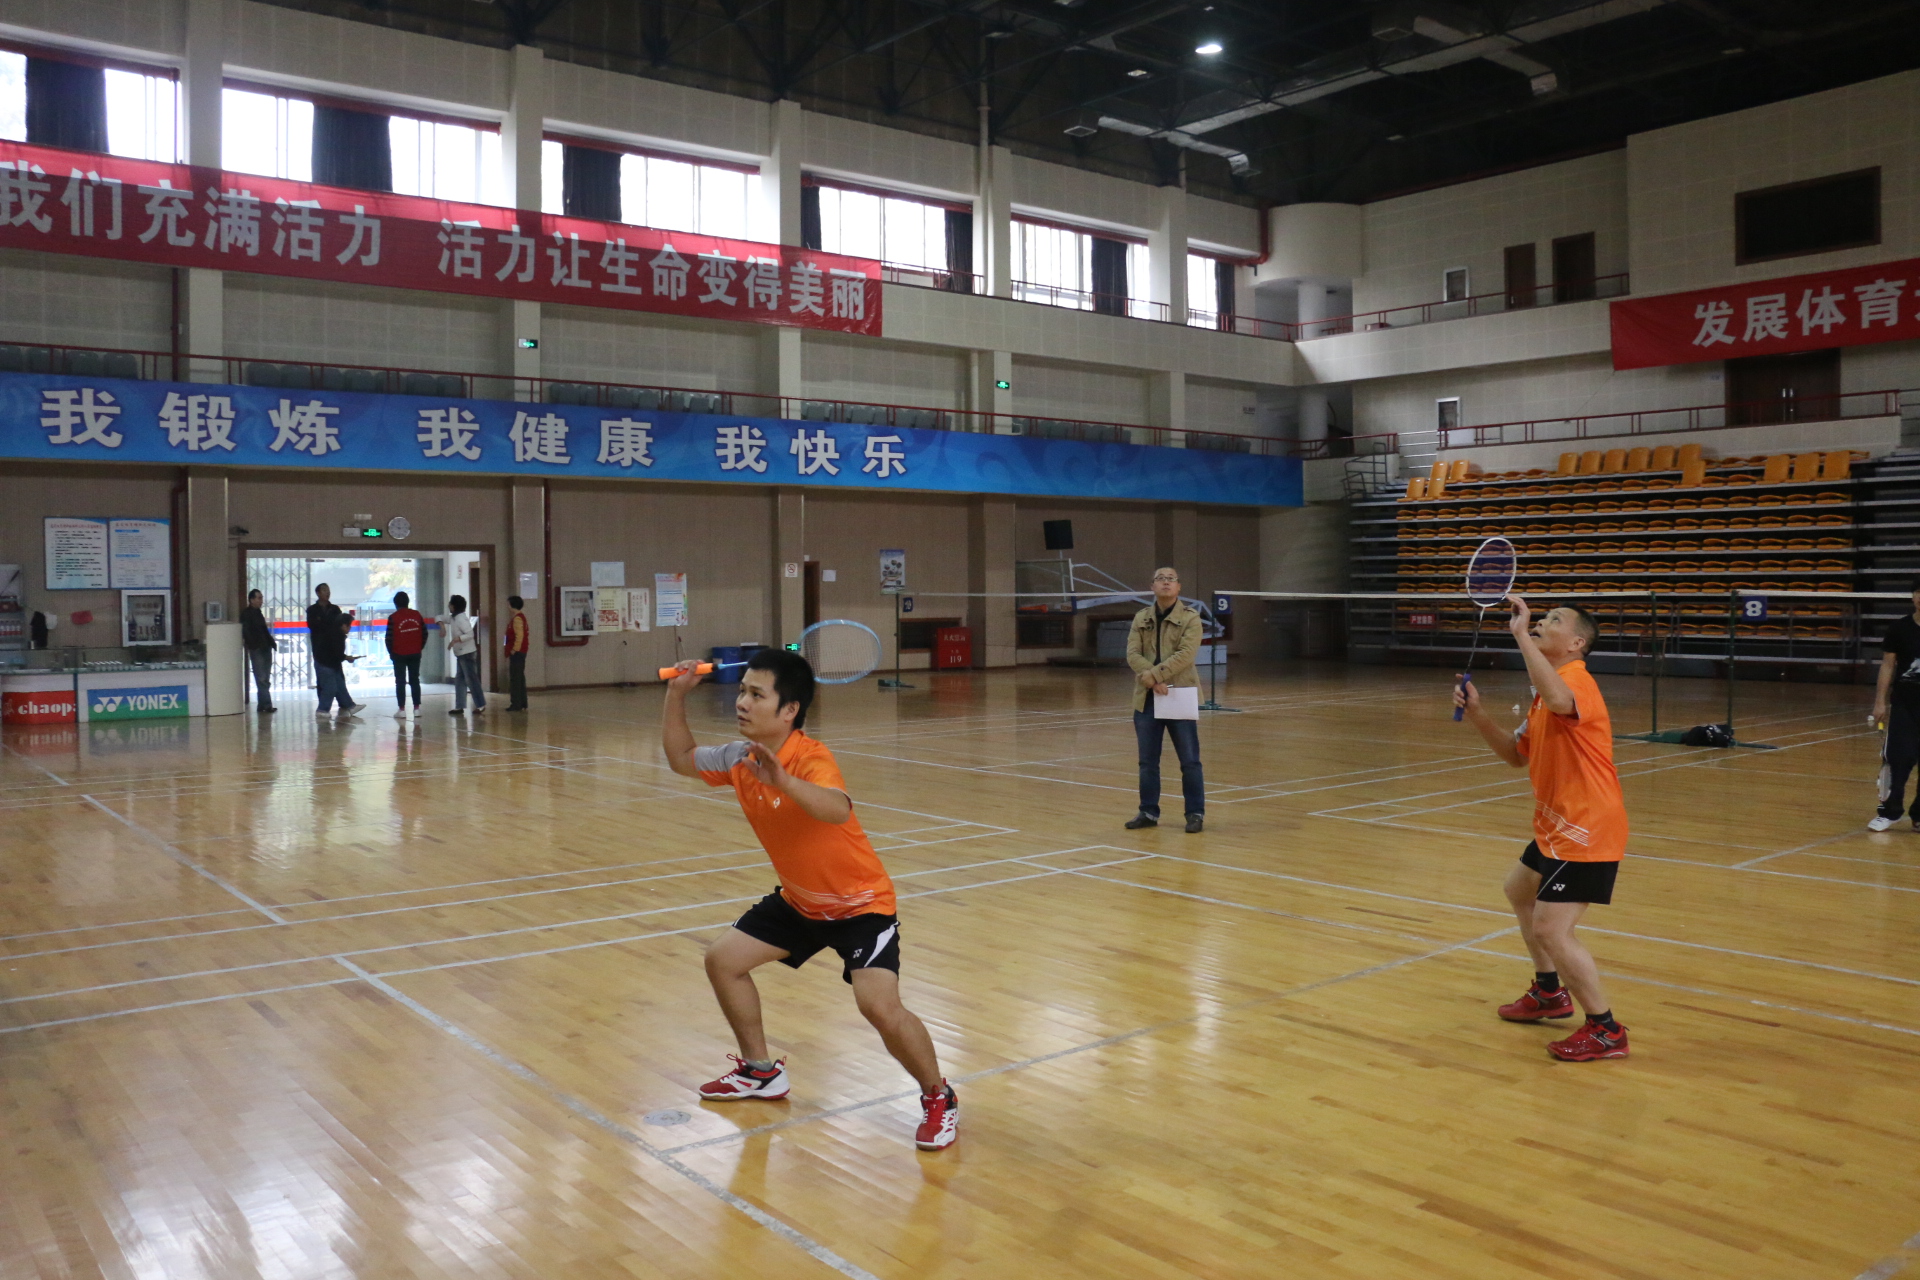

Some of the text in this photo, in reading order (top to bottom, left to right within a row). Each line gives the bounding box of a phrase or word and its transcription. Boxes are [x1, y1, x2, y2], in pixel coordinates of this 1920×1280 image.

[0, 159, 867, 320] 我们充满活力 活力让生命变得美丽
[1692, 277, 1920, 348] 发展体育
[40, 387, 907, 478] 我锻炼 我健康 我快乐
[1217, 598, 1229, 611] 9
[1744, 600, 1764, 618] 8
[950, 655, 962, 664] 119
[127, 693, 179, 711] YONEX
